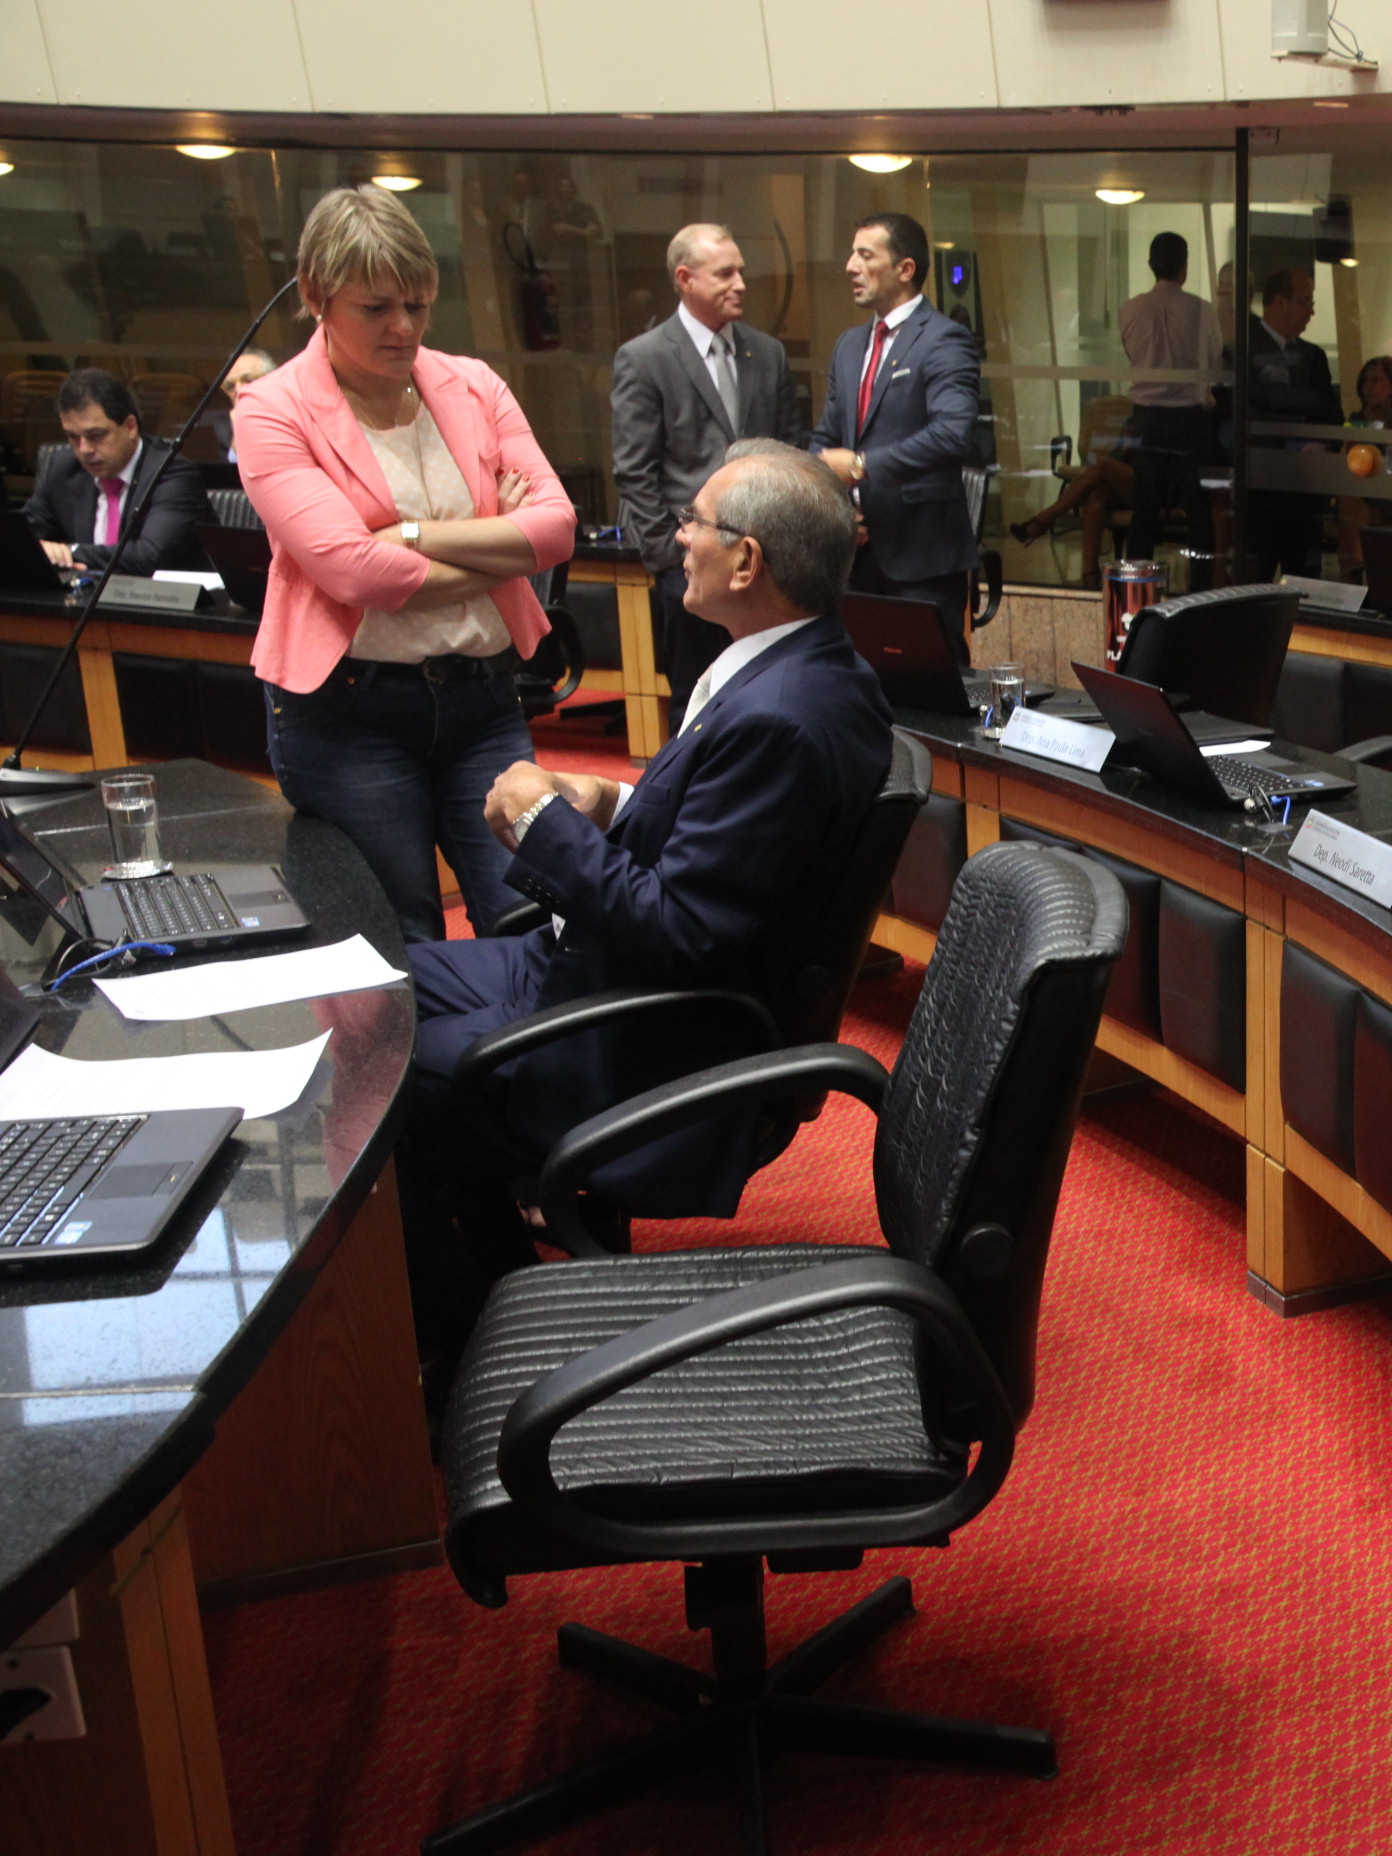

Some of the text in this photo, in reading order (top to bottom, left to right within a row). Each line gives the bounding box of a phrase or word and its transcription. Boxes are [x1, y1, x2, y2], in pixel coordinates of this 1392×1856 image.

[1020, 731, 1086, 758] Dep. Ana Paula Lima
[1313, 844, 1375, 885] Dep. Neodi Saretta
